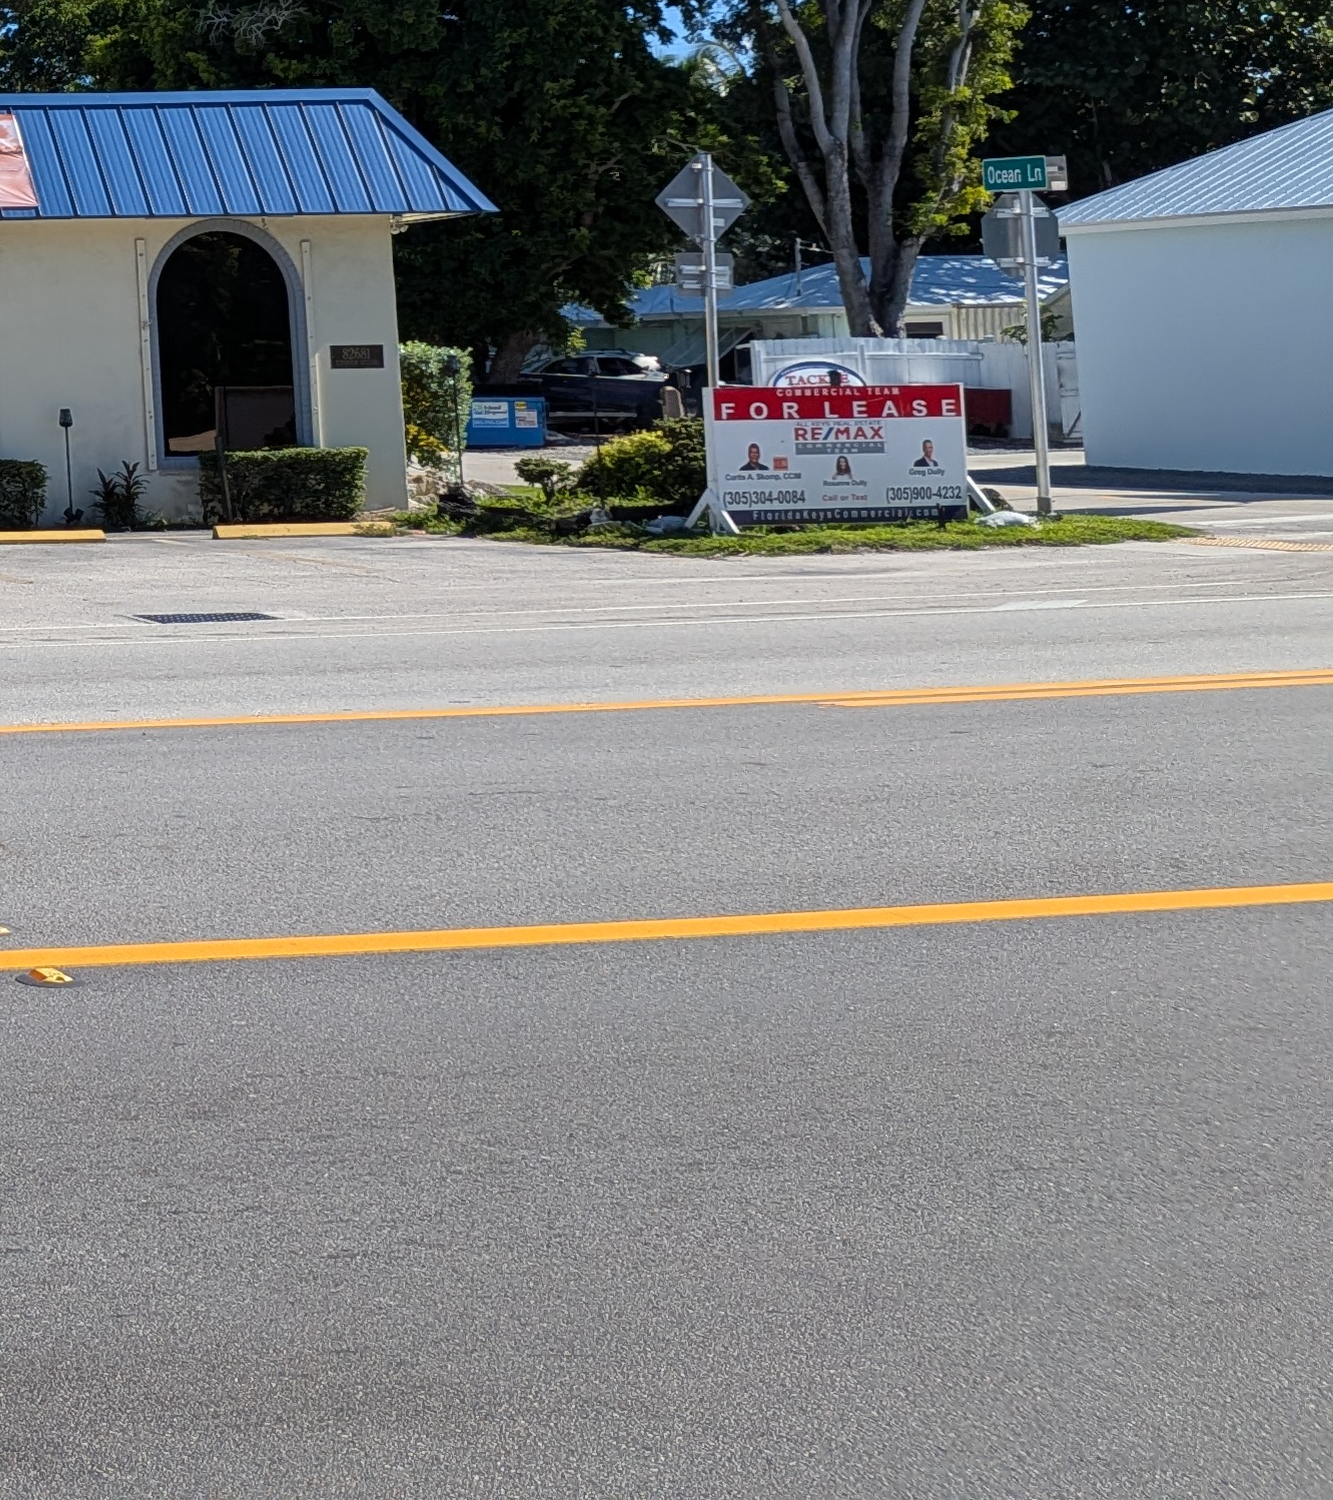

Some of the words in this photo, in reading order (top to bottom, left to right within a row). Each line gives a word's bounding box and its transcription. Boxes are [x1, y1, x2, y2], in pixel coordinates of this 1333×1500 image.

[987, 166, 1022, 184] Ocean
[1027, 164, 1043, 181] Ln
[785, 373, 851, 386] TACKE
[775, 388, 861, 396] COMMERCIAL
[867, 387, 900, 395] TEAM
[721, 401, 799, 420] FOR
[824, 399, 957, 418] LEASE
[794, 426, 885, 442] RE/MAX
[909, 468, 926, 476] Greg
[722, 490, 806, 508] (305)304-0084
[886, 486, 962, 504] (305)900-4232
